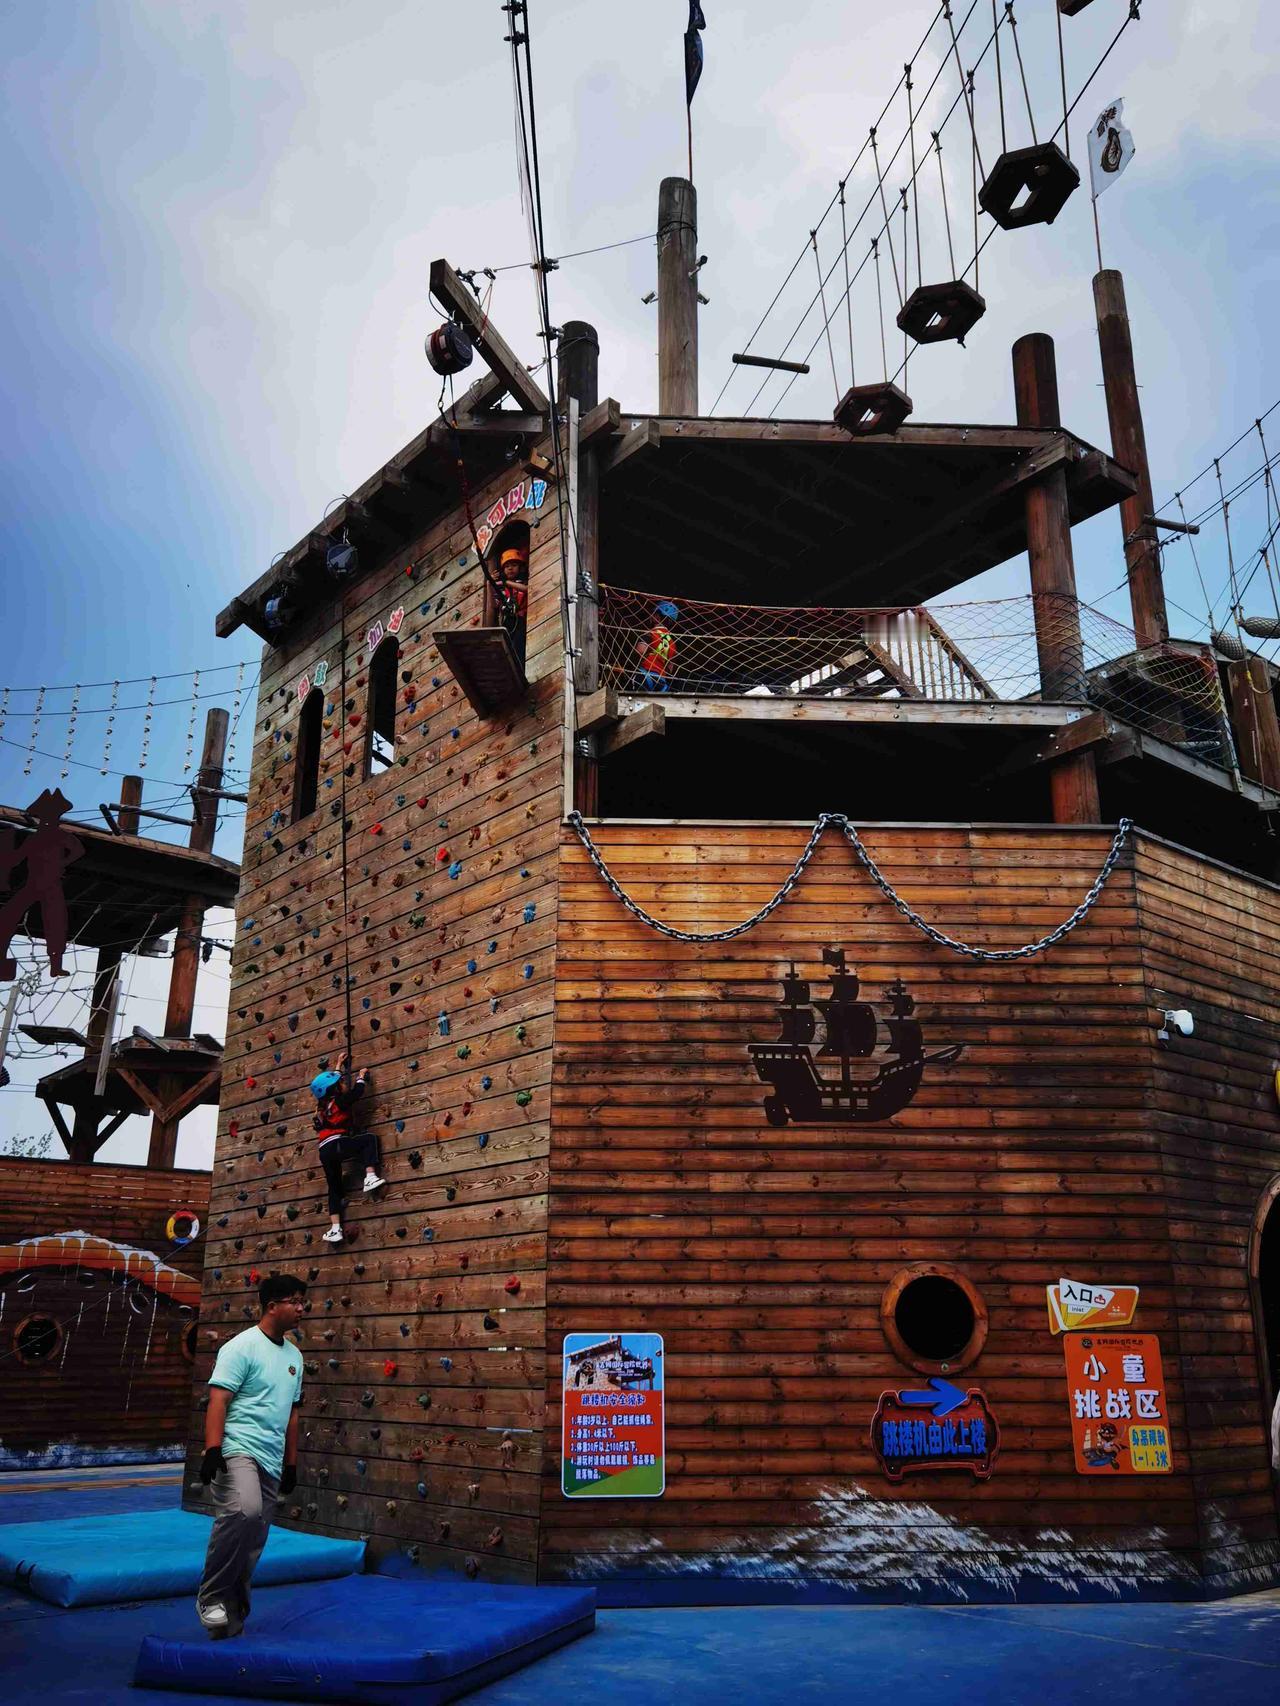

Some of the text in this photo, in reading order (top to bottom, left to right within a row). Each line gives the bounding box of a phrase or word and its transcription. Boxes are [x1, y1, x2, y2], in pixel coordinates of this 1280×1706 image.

[1063, 1285, 1093, 1304] 入口
[1083, 1354, 1146, 1384] 小童
[580, 1393, 646, 1407] 跳楼机安全须知
[1074, 1389, 1162, 1420] 挑战区
[882, 1417, 987, 1457] 跳楼机由此上楼
[1131, 1429, 1167, 1447] 身高限制
